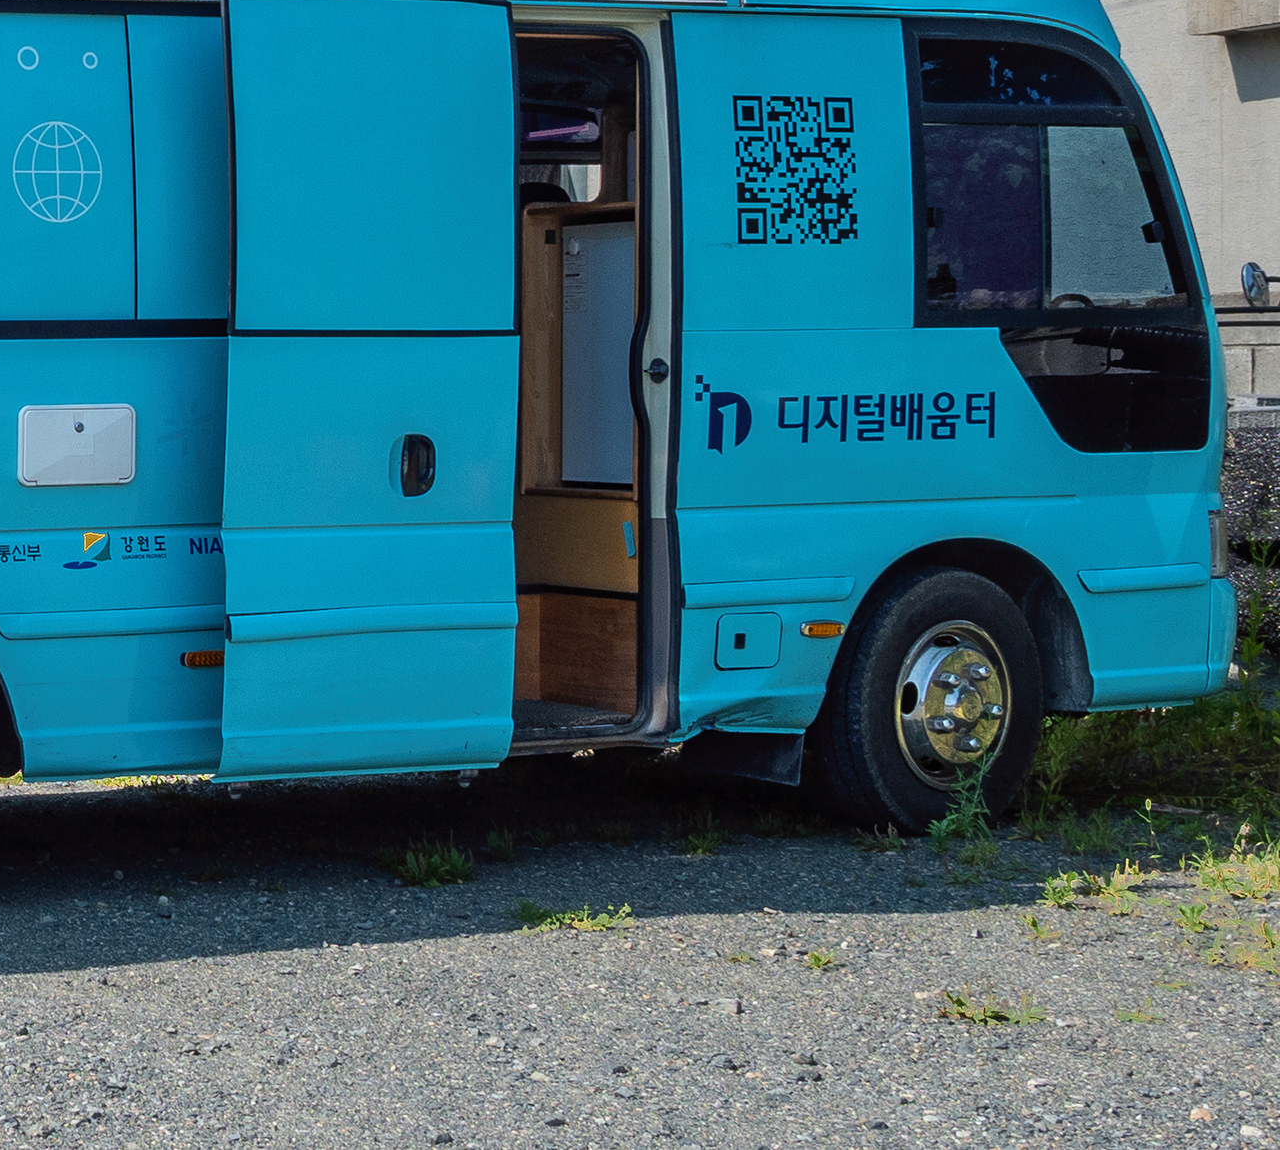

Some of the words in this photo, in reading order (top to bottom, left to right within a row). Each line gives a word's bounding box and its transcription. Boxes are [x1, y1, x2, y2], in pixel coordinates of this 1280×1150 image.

[777, 391, 996, 444] 디지털배움터
[120, 535, 167, 553] 강원도
[189, 536, 224, 555] NIA
